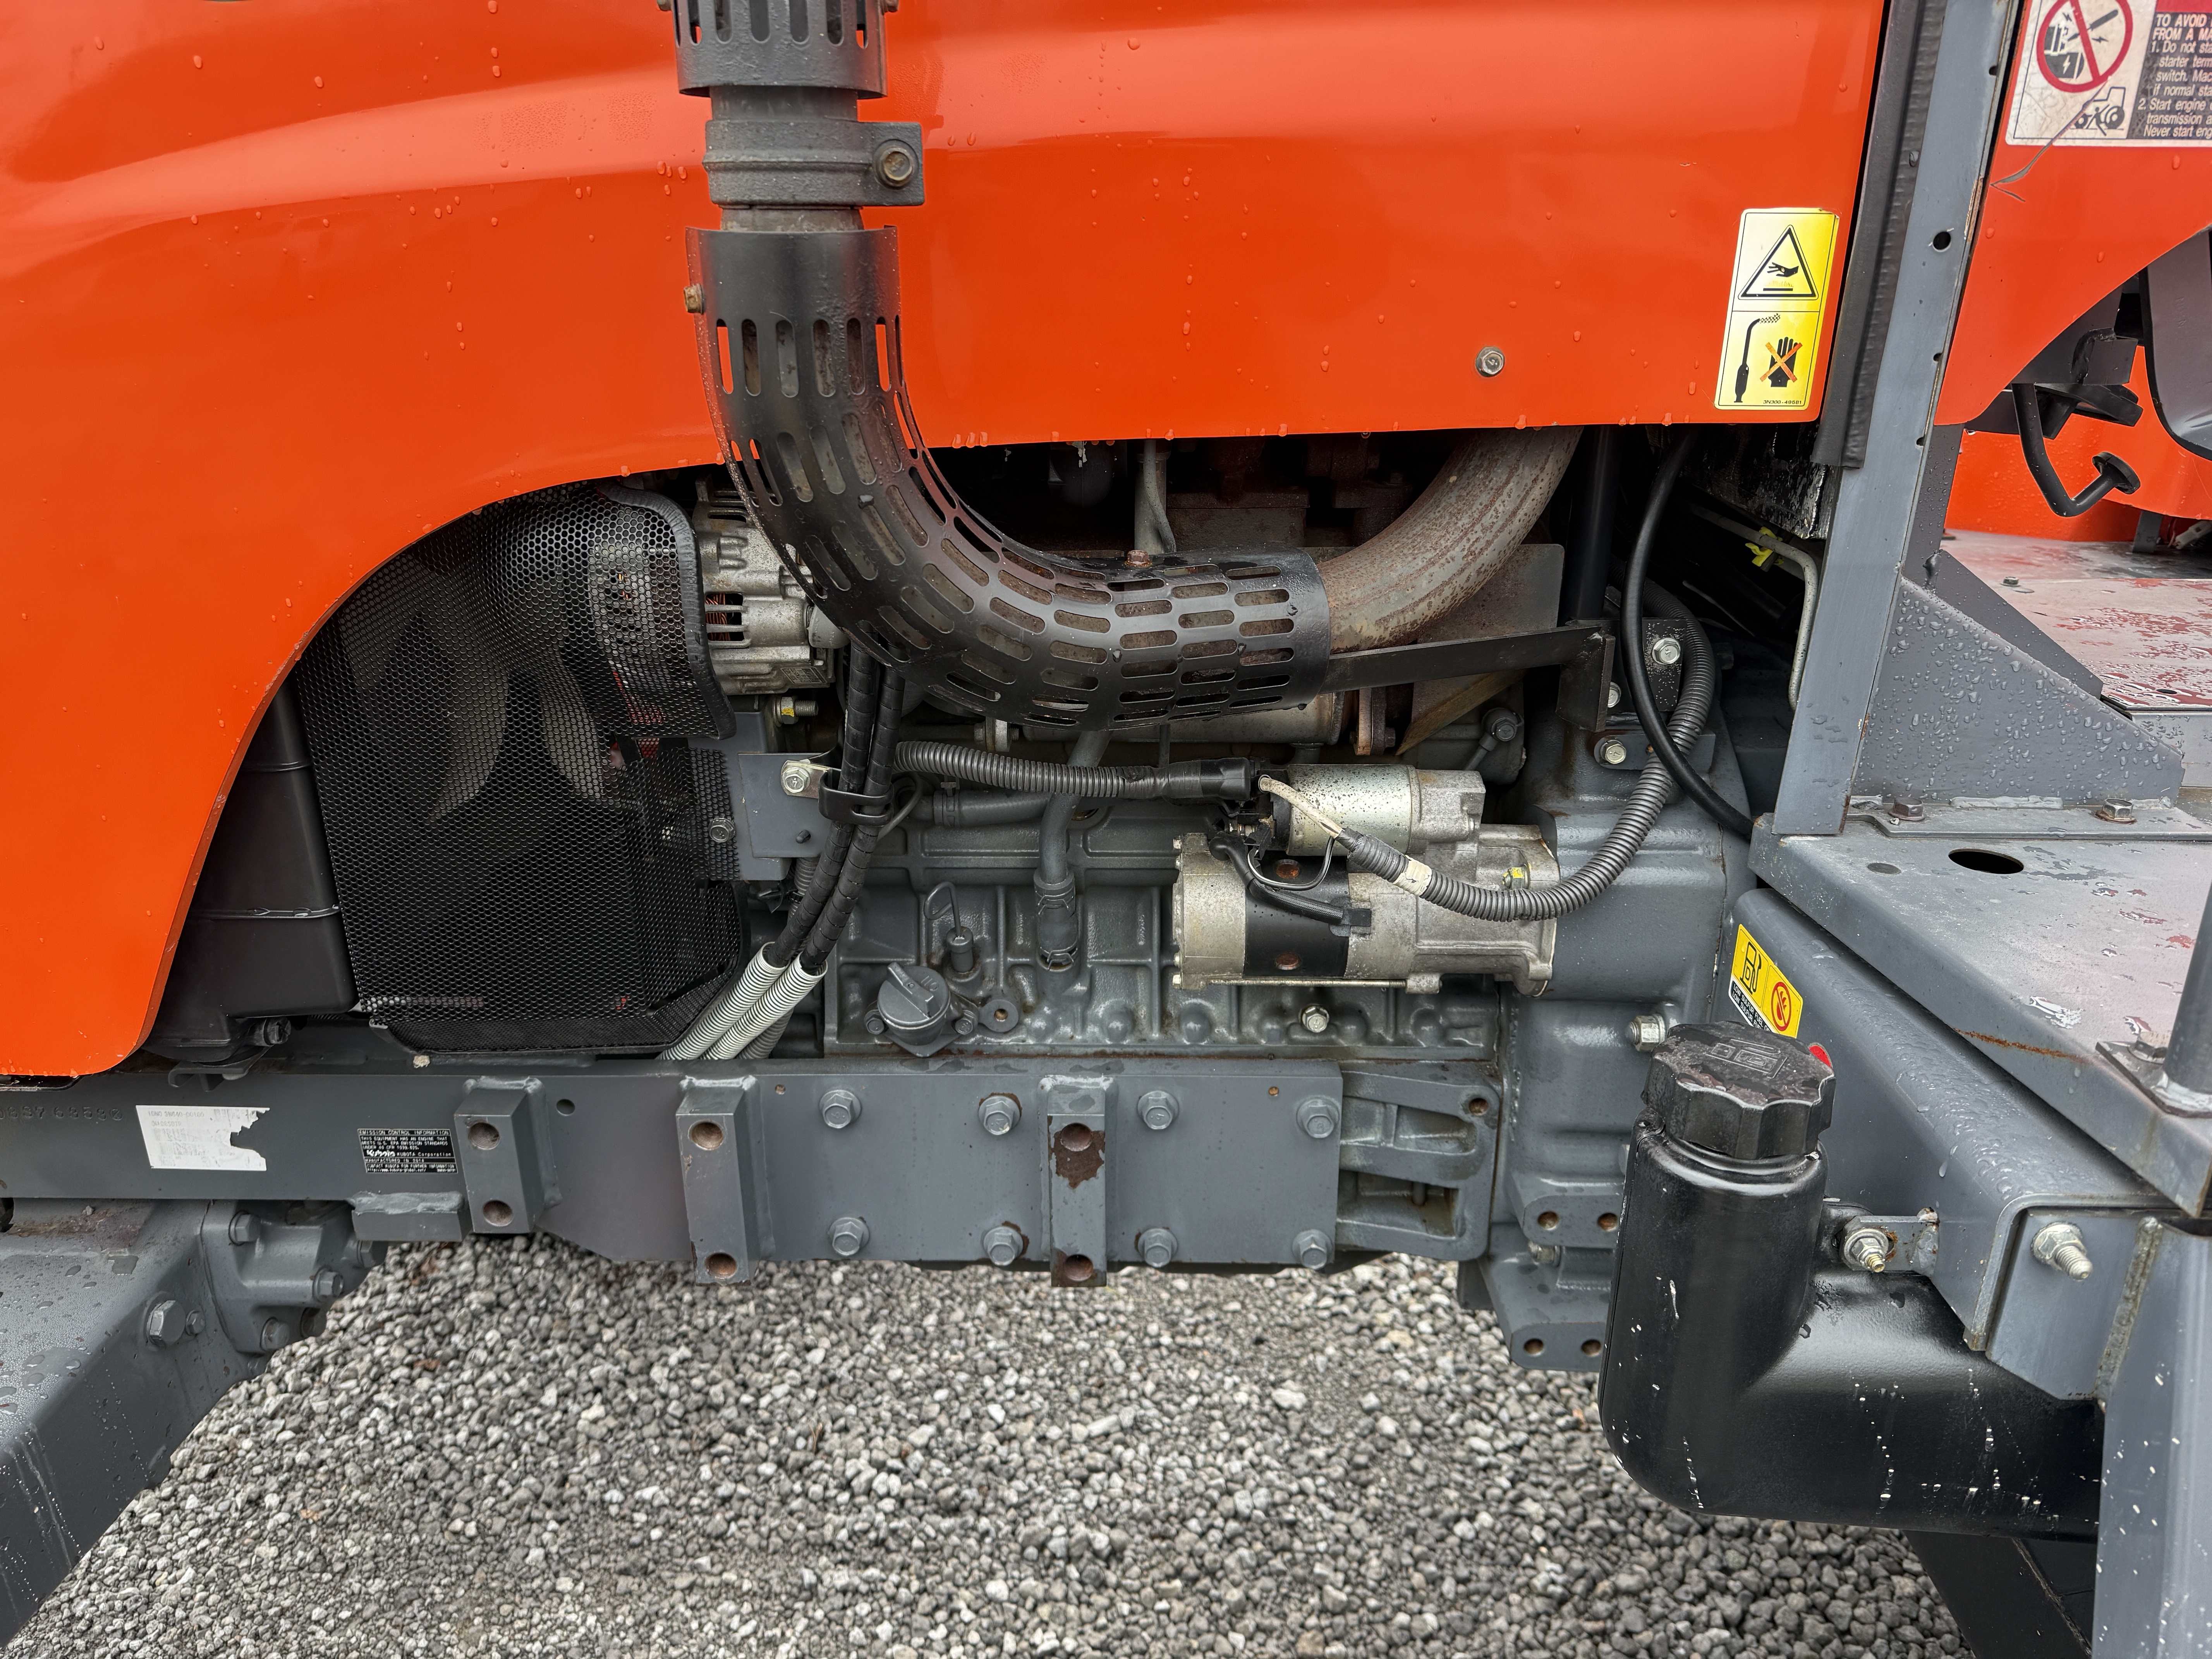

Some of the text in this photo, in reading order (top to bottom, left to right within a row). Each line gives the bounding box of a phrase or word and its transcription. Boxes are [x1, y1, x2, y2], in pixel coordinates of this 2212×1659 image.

[2157, 14, 2171, 27] TO
[2174, 14, 2207, 27] AVOID
[2152, 27, 2183, 40] FROM
[2185, 28, 2194, 40] A
[2151, 40, 2159, 53] 1.
[2162, 40, 2177, 53] Do
[2180, 41, 2197, 53] not
[2159, 55, 2189, 67] starter
[2156, 69, 2188, 82] switch.
[2153, 83, 2161, 96] if
[2164, 84, 2196, 96] normal
[2138, 98, 2147, 110] 2.
[2150, 98, 2172, 110] Start
[2175, 98, 2207, 113] engine
[2147, 112, 2203, 124] transmission
[2143, 124, 2171, 137] Never
[2173, 125, 2194, 137] start
[1732, 991, 1740, 1004] LOW
[1740, 1002, 1753, 1022] SULFUR
[1733, 984, 1741, 996] LOW
[1741, 994, 1754, 1015] SULFUR
[1754, 1012, 1764, 1027] FUEL
